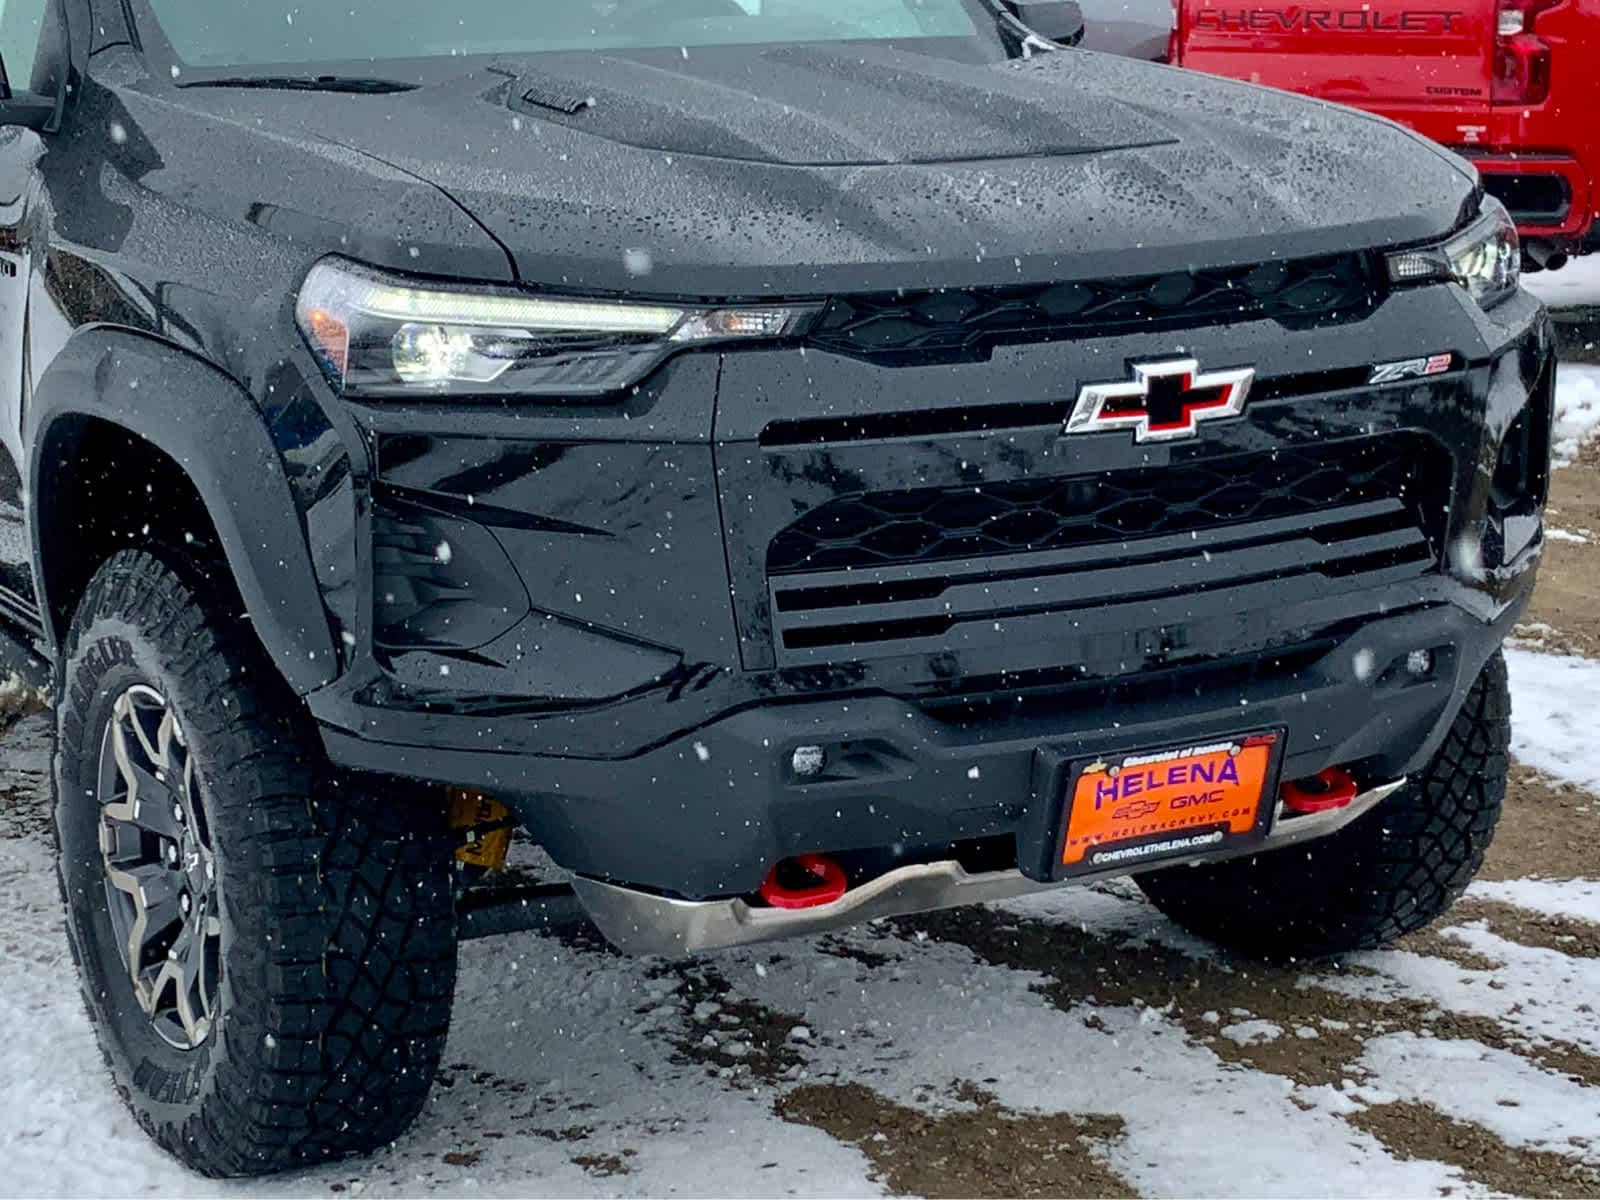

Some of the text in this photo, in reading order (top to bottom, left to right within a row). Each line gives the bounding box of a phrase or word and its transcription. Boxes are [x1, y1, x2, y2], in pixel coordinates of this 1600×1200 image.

[1195, 9, 1462, 32] CHEVROLET
[1425, 86, 1483, 97] CUSTOM
[1369, 353, 1452, 384] ZR2
[1095, 758, 1240, 810] HELENA
[1170, 790, 1225, 810] GMC
